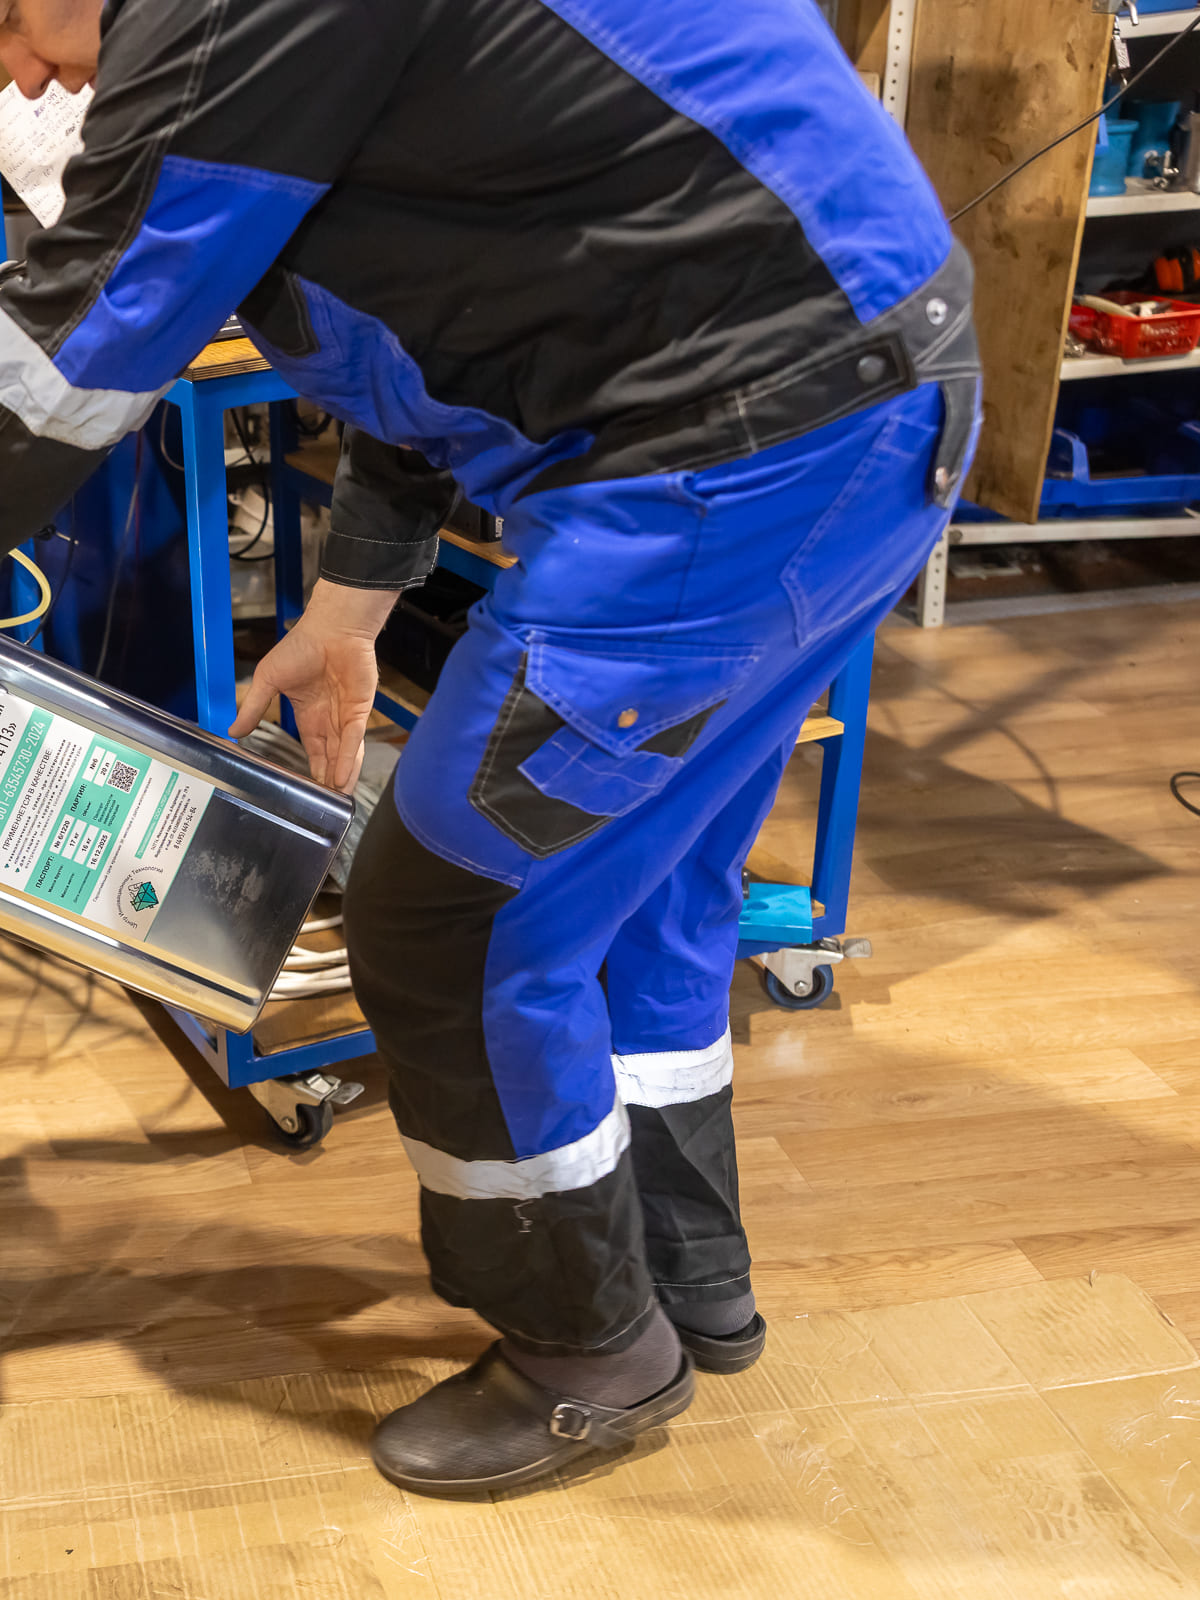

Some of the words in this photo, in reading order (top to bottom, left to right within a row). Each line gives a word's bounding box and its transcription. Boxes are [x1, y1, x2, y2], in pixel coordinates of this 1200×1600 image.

[100, 767, 107, 775] 20
[70, 783, 87, 812] ПАРТИЯ:
[1, 794, 32, 850] ПРИМЕНЯЕТСЯ
[53, 840, 60, 848] №
[57, 820, 70, 839] 6/1220
[90, 834, 107, 864] 16.12.2025
[35, 855, 54, 888] ПАСПОРТ:
